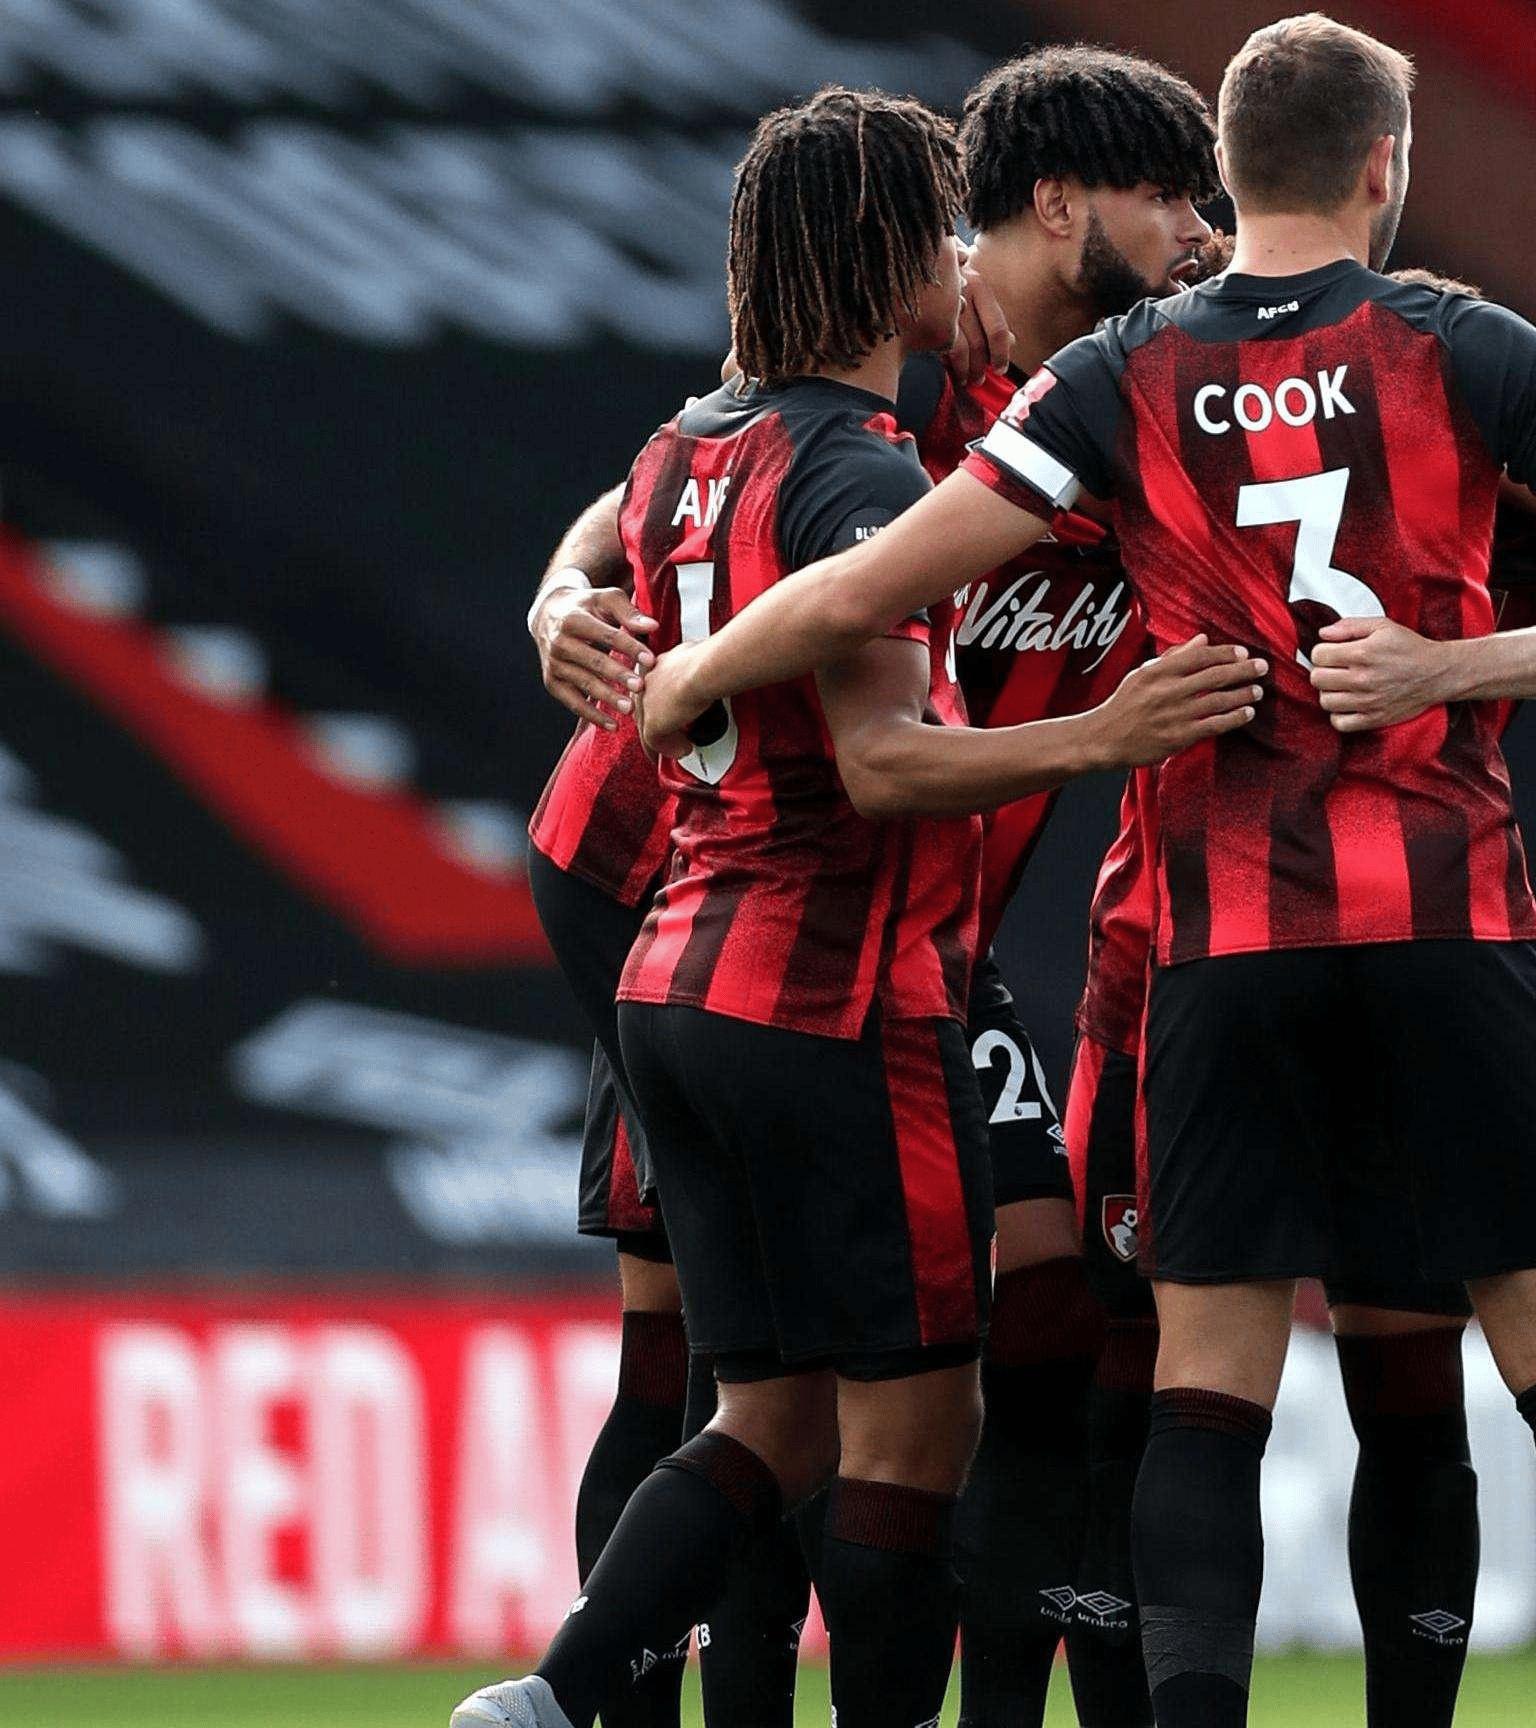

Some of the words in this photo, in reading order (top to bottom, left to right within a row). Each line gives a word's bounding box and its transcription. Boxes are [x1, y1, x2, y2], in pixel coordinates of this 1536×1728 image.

[1193, 364, 1357, 435] COOK
[1236, 466, 1387, 674] 3
[956, 571, 1132, 675] Vitality
[95, 1315, 432, 1658] RED
[1077, 1611, 1129, 1629] umbro
